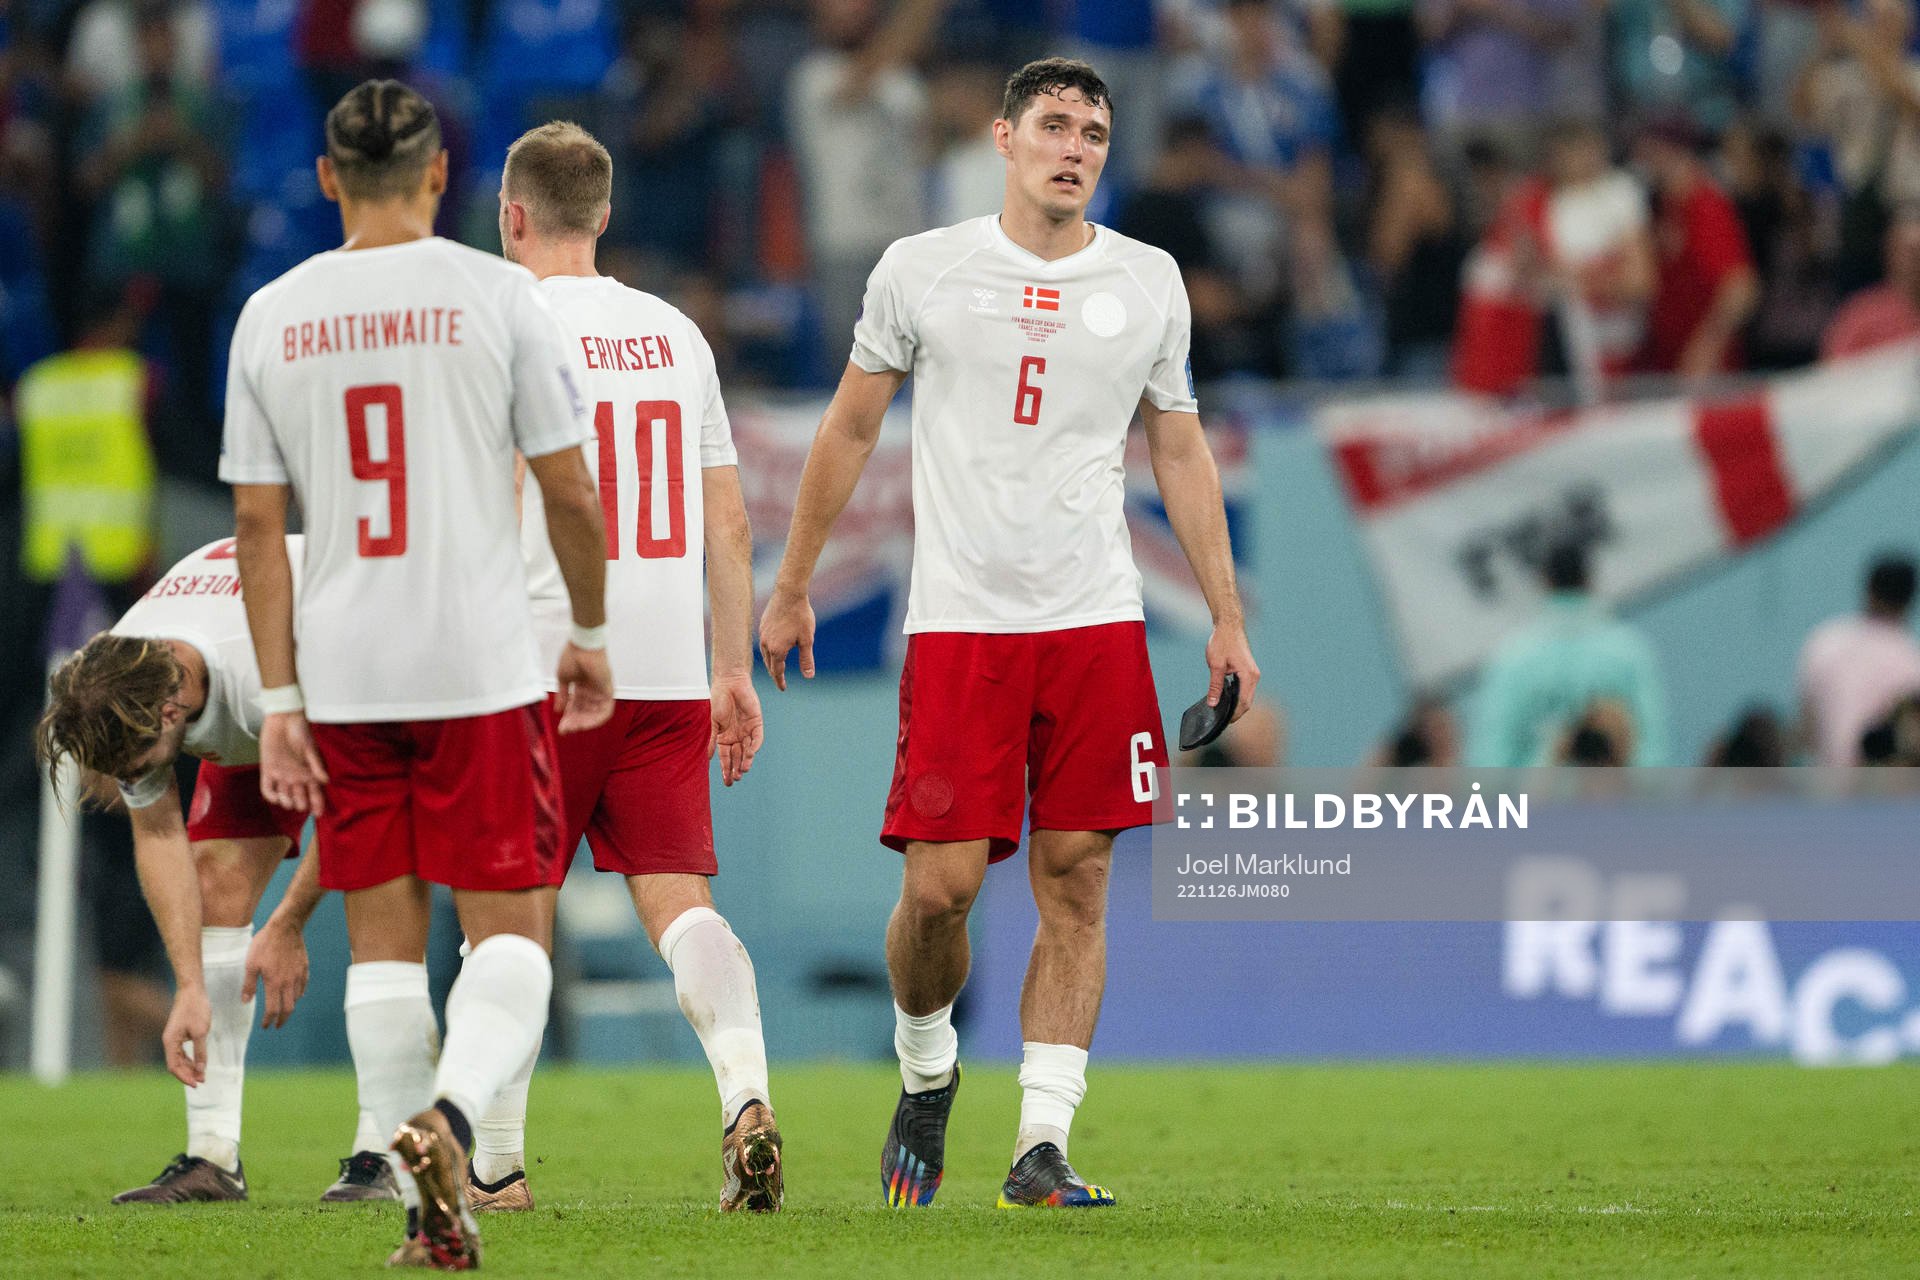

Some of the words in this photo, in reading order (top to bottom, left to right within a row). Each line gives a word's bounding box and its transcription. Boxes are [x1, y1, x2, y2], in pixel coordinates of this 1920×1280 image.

[284, 307, 463, 363] BRAITHWAITE
[581, 335, 674, 371] ERIKSEN
[1014, 355, 1046, 425] 6
[344, 383, 407, 559] 9
[594, 400, 686, 560] 10
[145, 574, 241, 600] NDERSE
[1130, 731, 1160, 803] 6
[1504, 856, 1920, 1067] REAC
